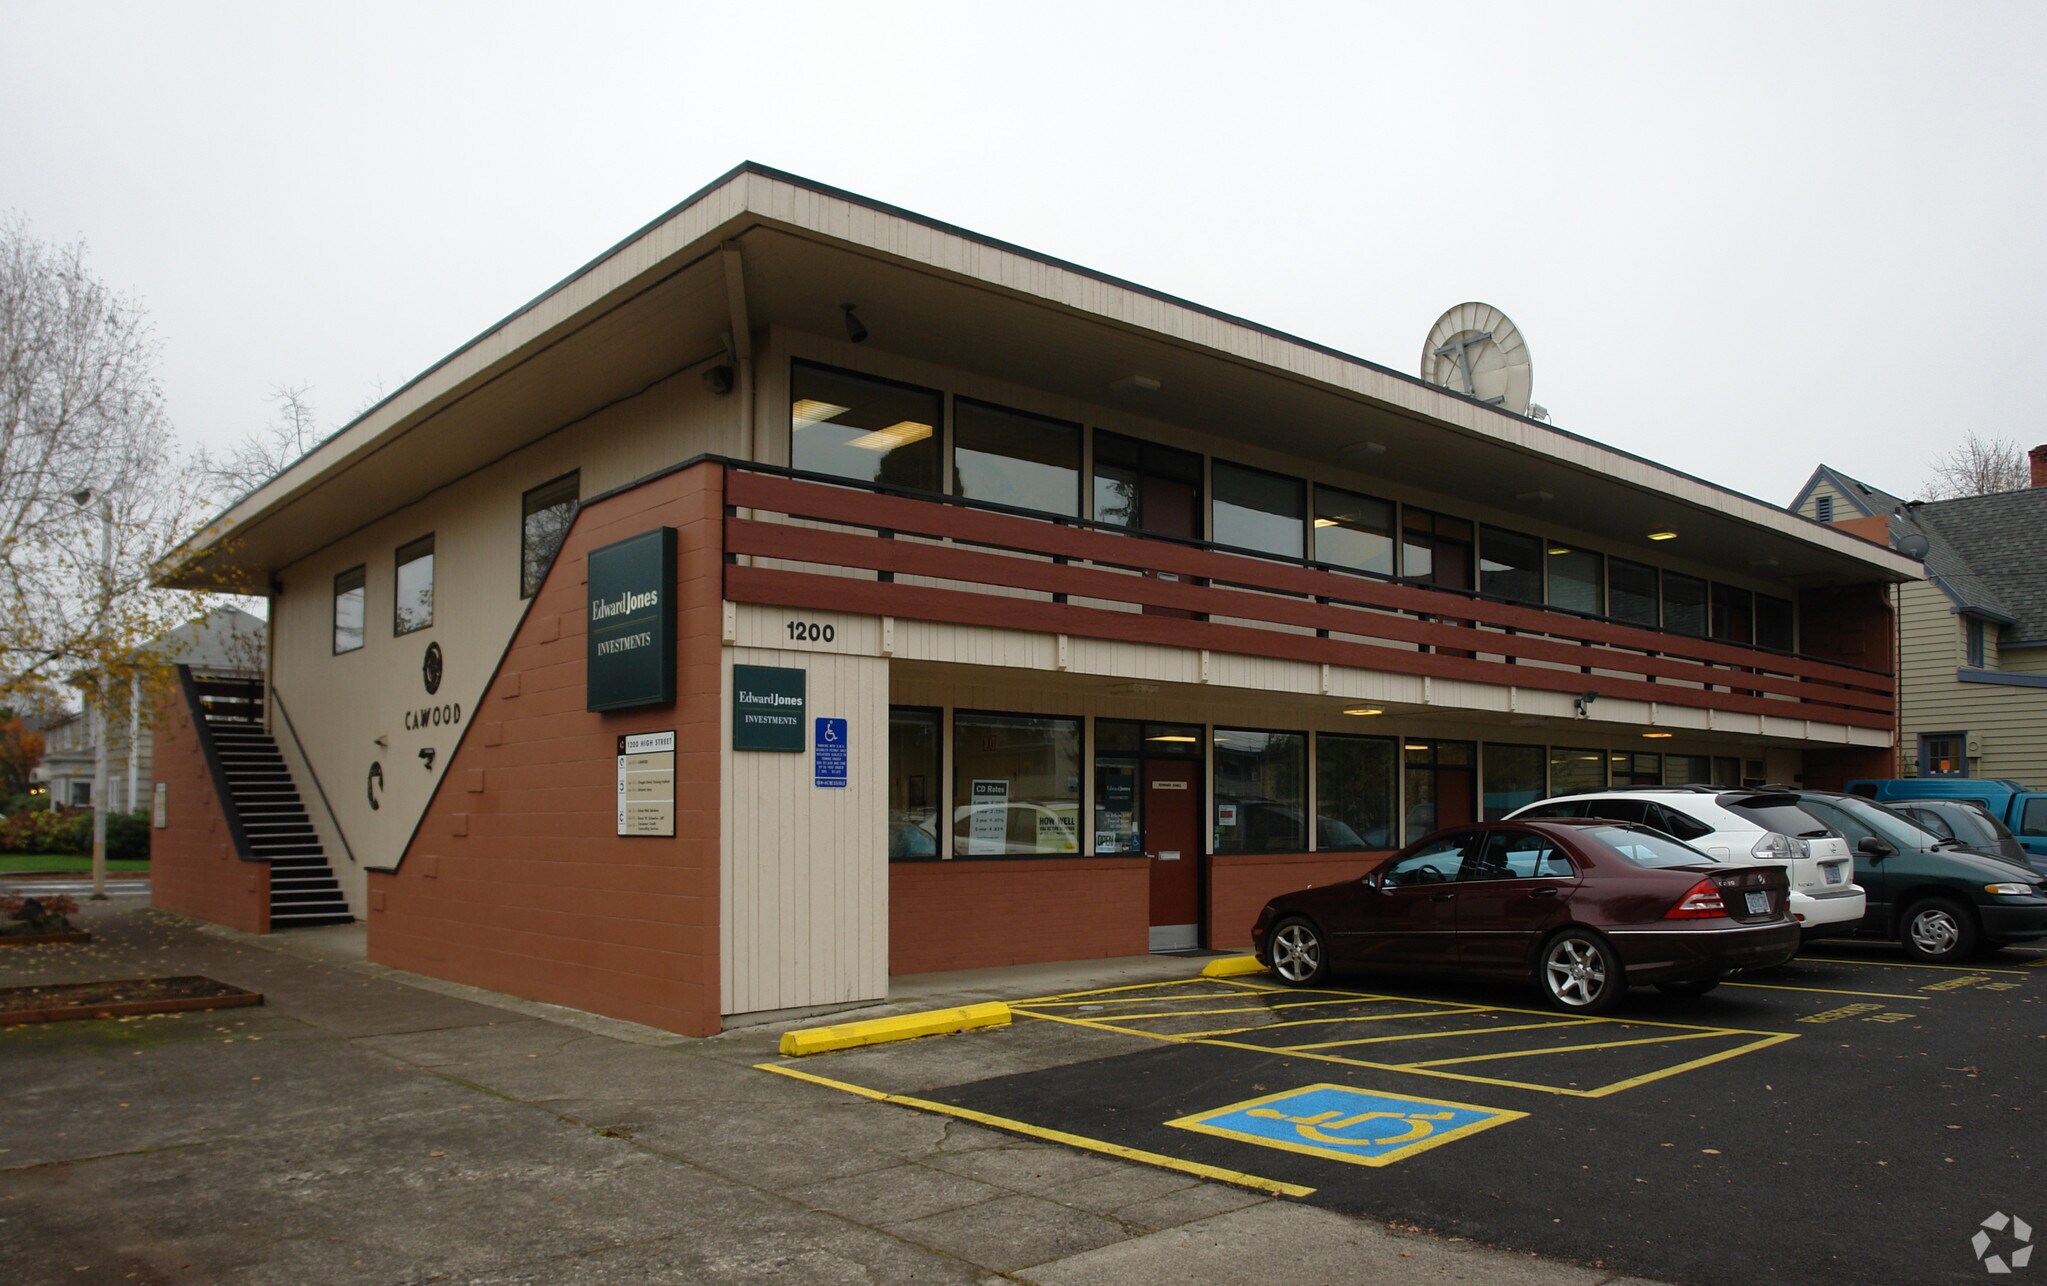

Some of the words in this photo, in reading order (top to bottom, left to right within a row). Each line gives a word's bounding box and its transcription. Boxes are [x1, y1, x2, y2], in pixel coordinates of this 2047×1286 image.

[787, 621, 835, 643] 1200
[597, 632, 651, 656] INVESTMENTS
[405, 703, 461, 731] CAWOOD
[745, 714, 797, 725] INVESTMENTS
[640, 739, 654, 747] HIGH
[655, 737, 672, 746] STREET
[976, 785, 986, 793] CD
[987, 785, 1005, 793] Rates
[1039, 817, 1055, 825] HOW
[1057, 817, 1075, 825] WELL
[1098, 835, 1114, 847] OPEN
